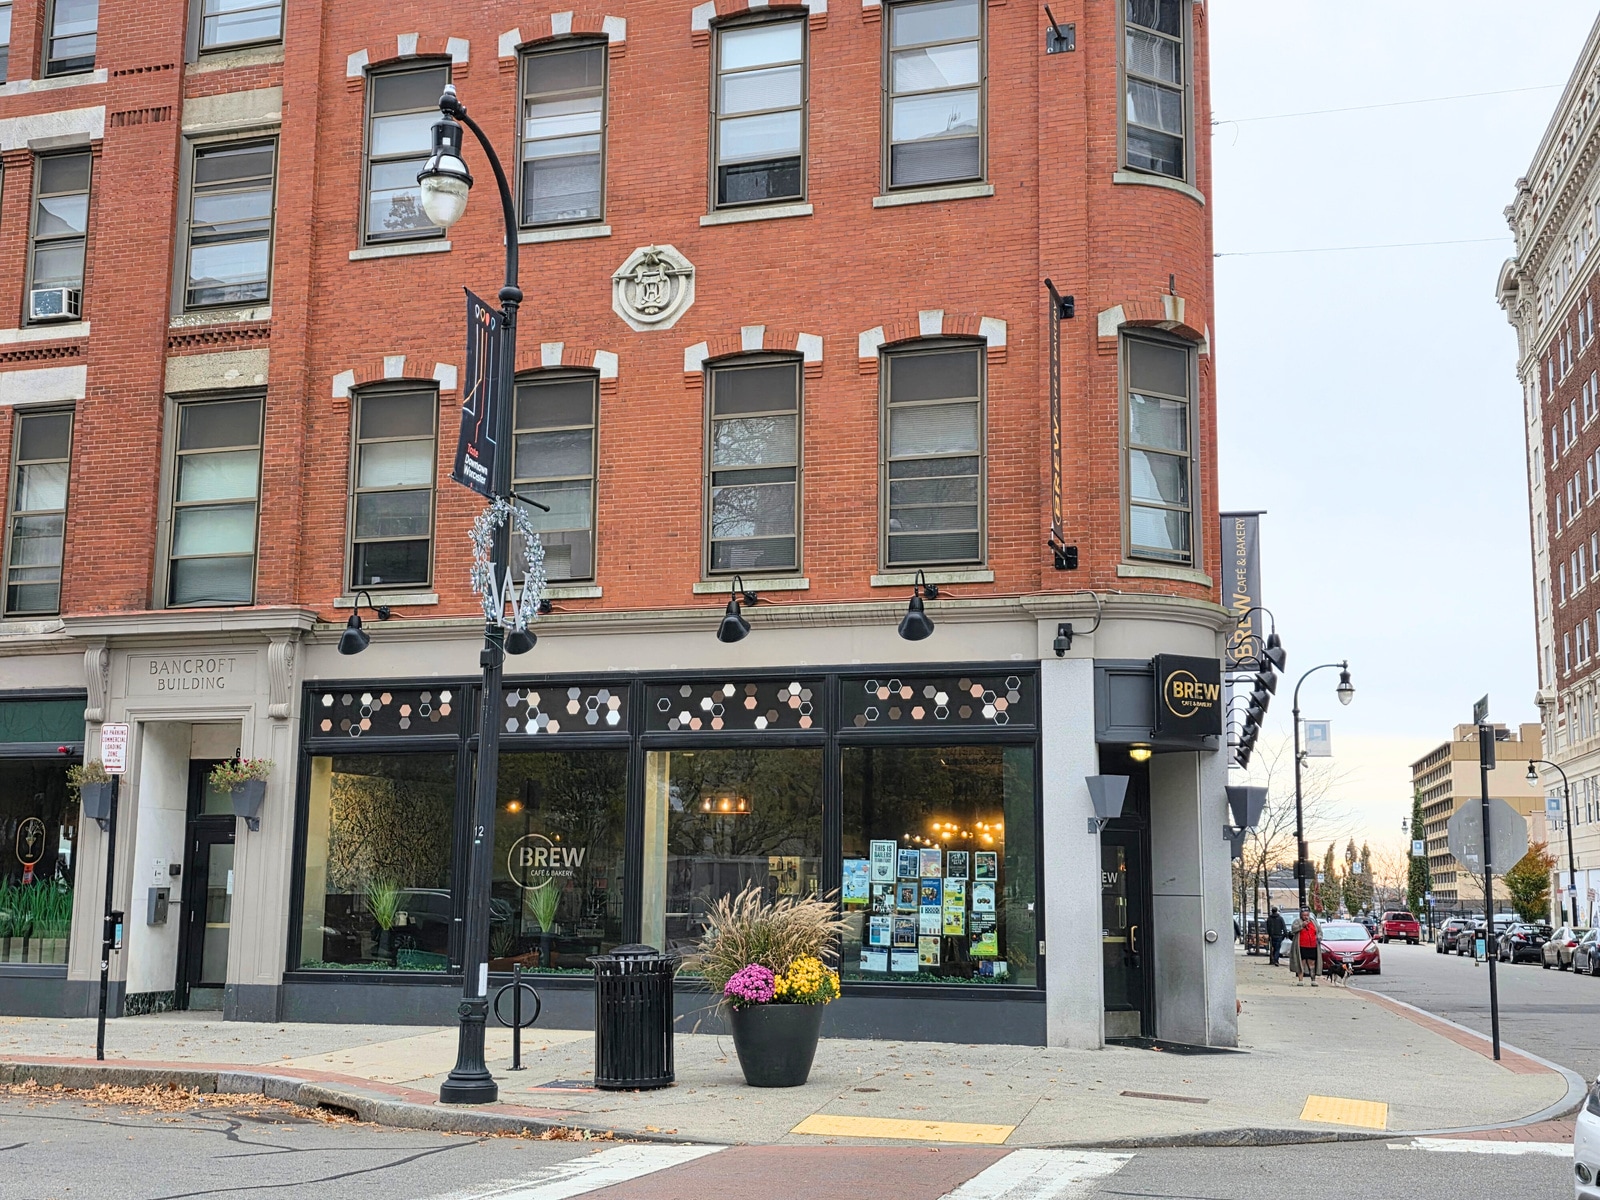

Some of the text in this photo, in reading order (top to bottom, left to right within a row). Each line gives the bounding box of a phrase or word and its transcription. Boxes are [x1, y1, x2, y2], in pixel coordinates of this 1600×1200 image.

[464, 453, 488, 476] Downtown
[463, 464, 487, 485] Worcester
[1235, 517, 1247, 556] BAKERY
[1236, 557, 1247, 567] &
[1235, 569, 1247, 594] CAFÉ
[149, 658, 236, 675] BANCROFT
[157, 677, 225, 691] BUILDING
[1173, 681, 1220, 701] BREW
[474, 825, 484, 837] 12
[874, 844, 886, 852] THIS
[519, 847, 586, 867] BREW
[551, 869, 574, 877] BAKERY
[1101, 872, 1118, 883] EW
